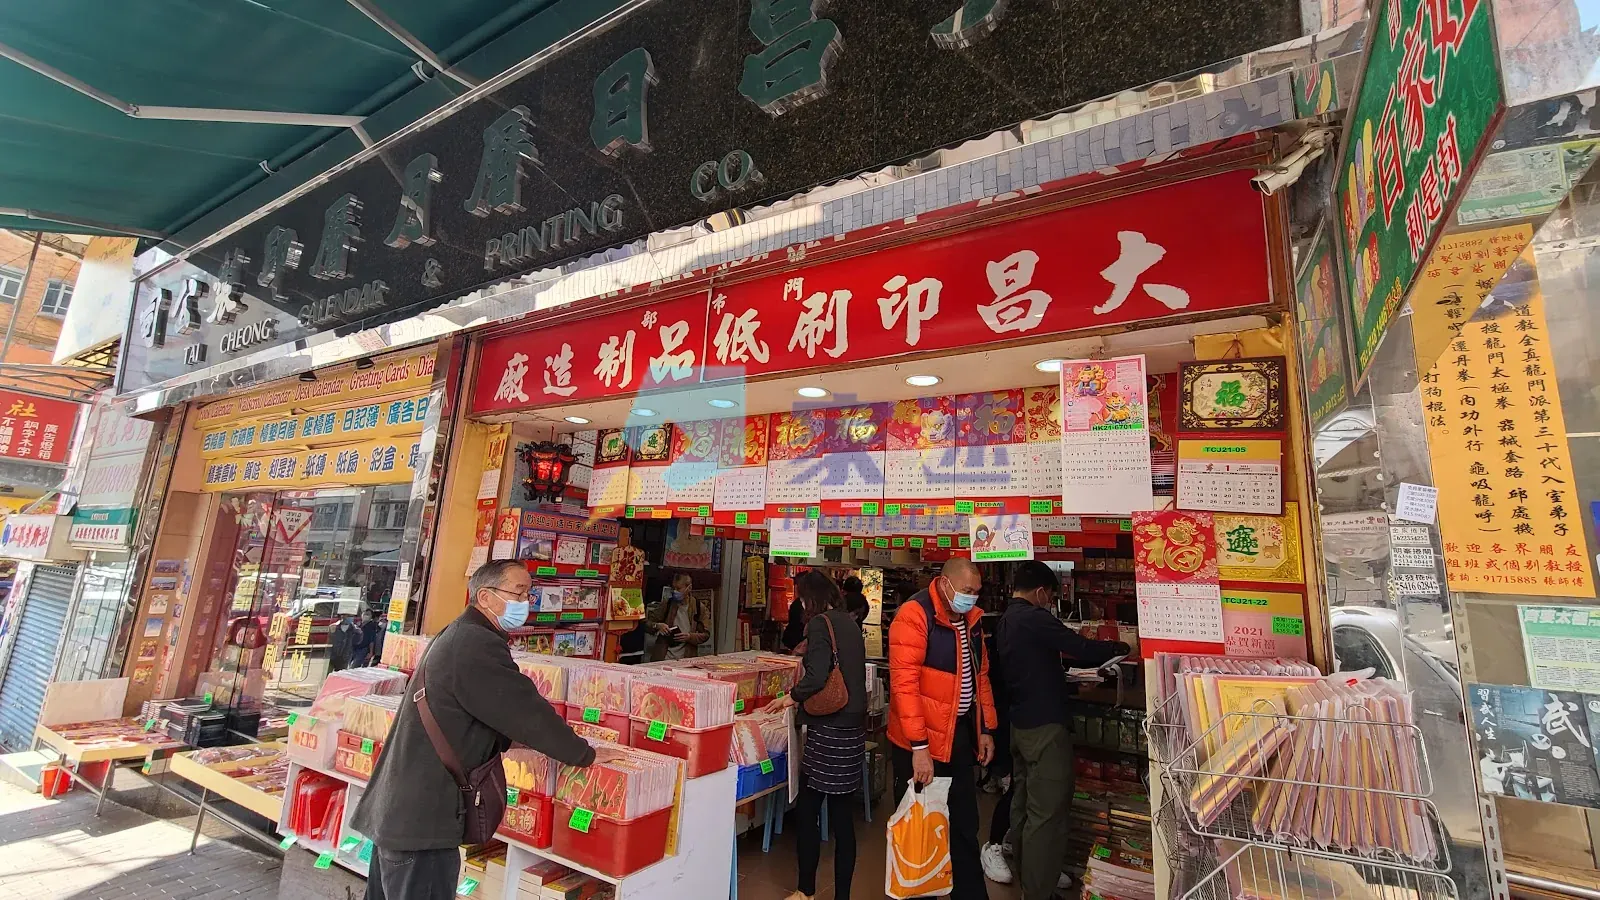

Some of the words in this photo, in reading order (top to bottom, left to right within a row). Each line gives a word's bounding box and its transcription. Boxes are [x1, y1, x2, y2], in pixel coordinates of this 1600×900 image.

[1405, 111, 1463, 264] 利是封
[184, 342, 205, 366] TAI
[220, 317, 275, 354] CHEONG
[299, 280, 388, 327] CALENDAR
[421, 257, 445, 288] &
[484, 193, 624, 272] PRINTING
[690, 149, 764, 201] CO.
[313, 376, 346, 397] Calendar
[350, 367, 383, 390] Greeting
[385, 359, 410, 384] Cards
[5, 399, 39, 418] 社
[1514, 304, 1569, 537] 道教全真龍門派第三十代入室弟子
[1444, 541, 1582, 557] 歡迎各界朋友
[1445, 557, 1585, 573] 組班或個別教授
[1483, 573, 1537, 585] 91715885
[1224, 597, 1267, 606] TCJ21-22
[1233, 626, 1264, 636] 2021
[1226, 636, 1276, 650] 恭賀新禧
[1477, 688, 1497, 740] 習武人生
[1541, 692, 1592, 748] 武
